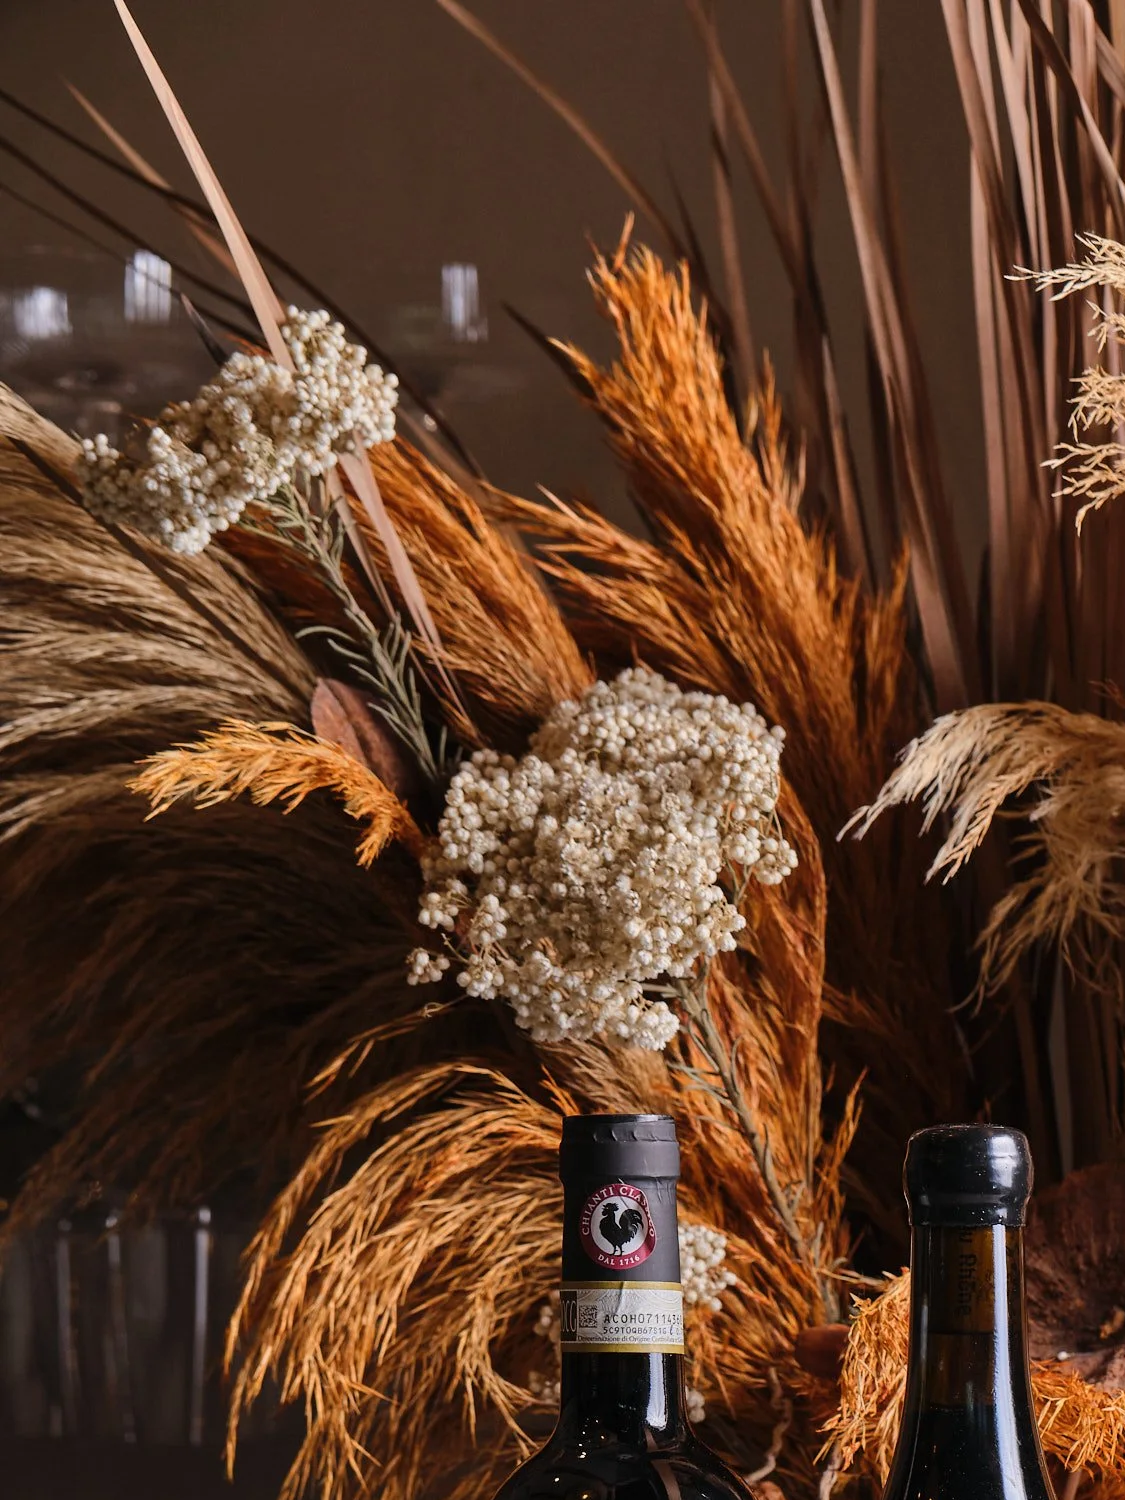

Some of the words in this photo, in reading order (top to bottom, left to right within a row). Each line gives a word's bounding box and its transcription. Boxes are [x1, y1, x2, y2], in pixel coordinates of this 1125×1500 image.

[582, 1186, 615, 1236] CHIANTI
[598, 1254, 615, 1265] DAL
[620, 1254, 640, 1265] 1716
